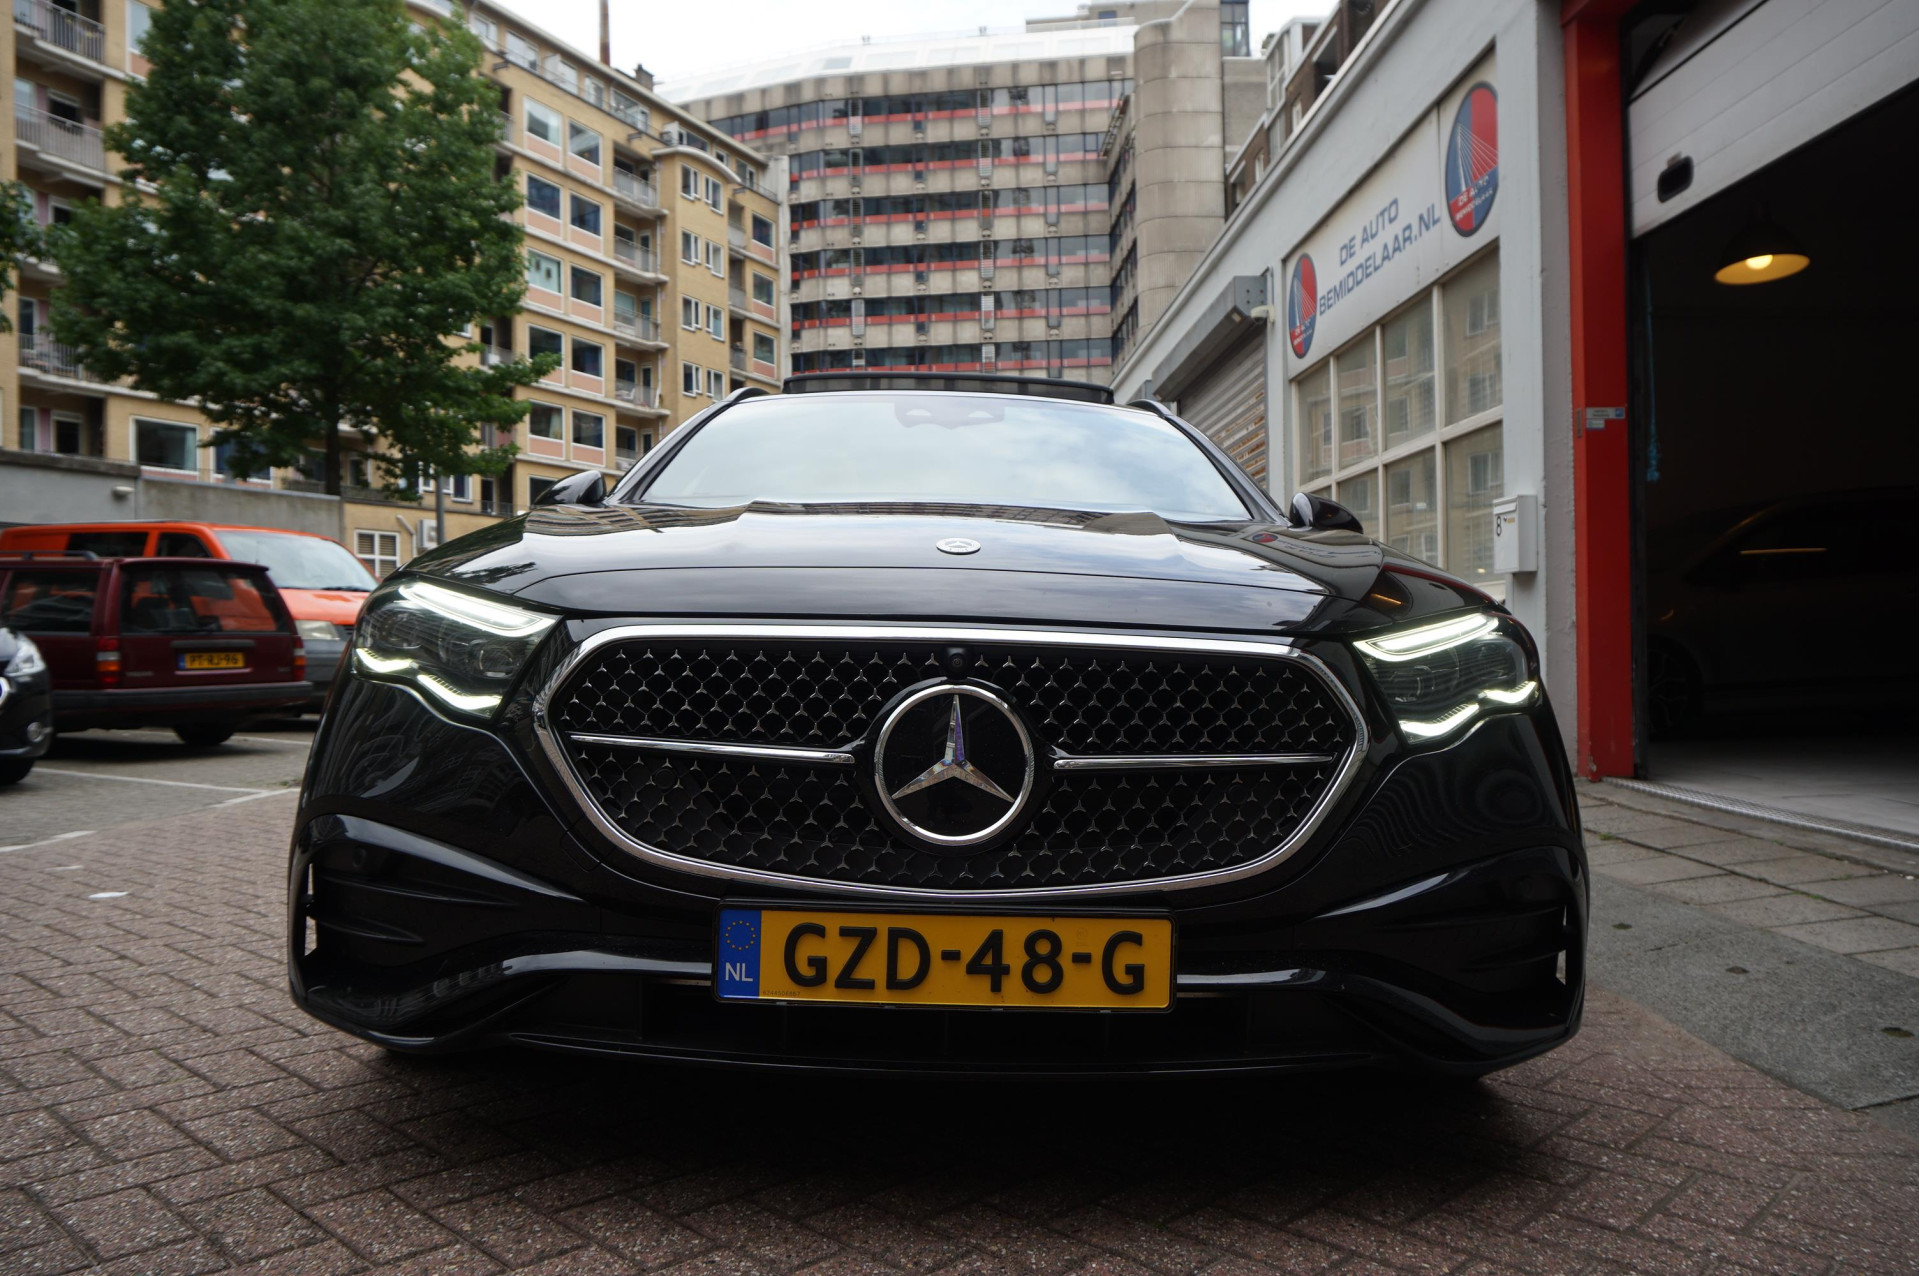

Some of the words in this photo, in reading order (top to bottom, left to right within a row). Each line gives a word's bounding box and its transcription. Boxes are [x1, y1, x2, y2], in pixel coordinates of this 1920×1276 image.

[1319, 203, 1441, 316] BEMIDDELAAR.NL
[1340, 235, 1356, 267] DE
[1361, 197, 1399, 250] AUTO
[1496, 515, 1503, 537] 8
[725, 962, 754, 982] NL
[783, 922, 1146, 995] GZD-48-G
